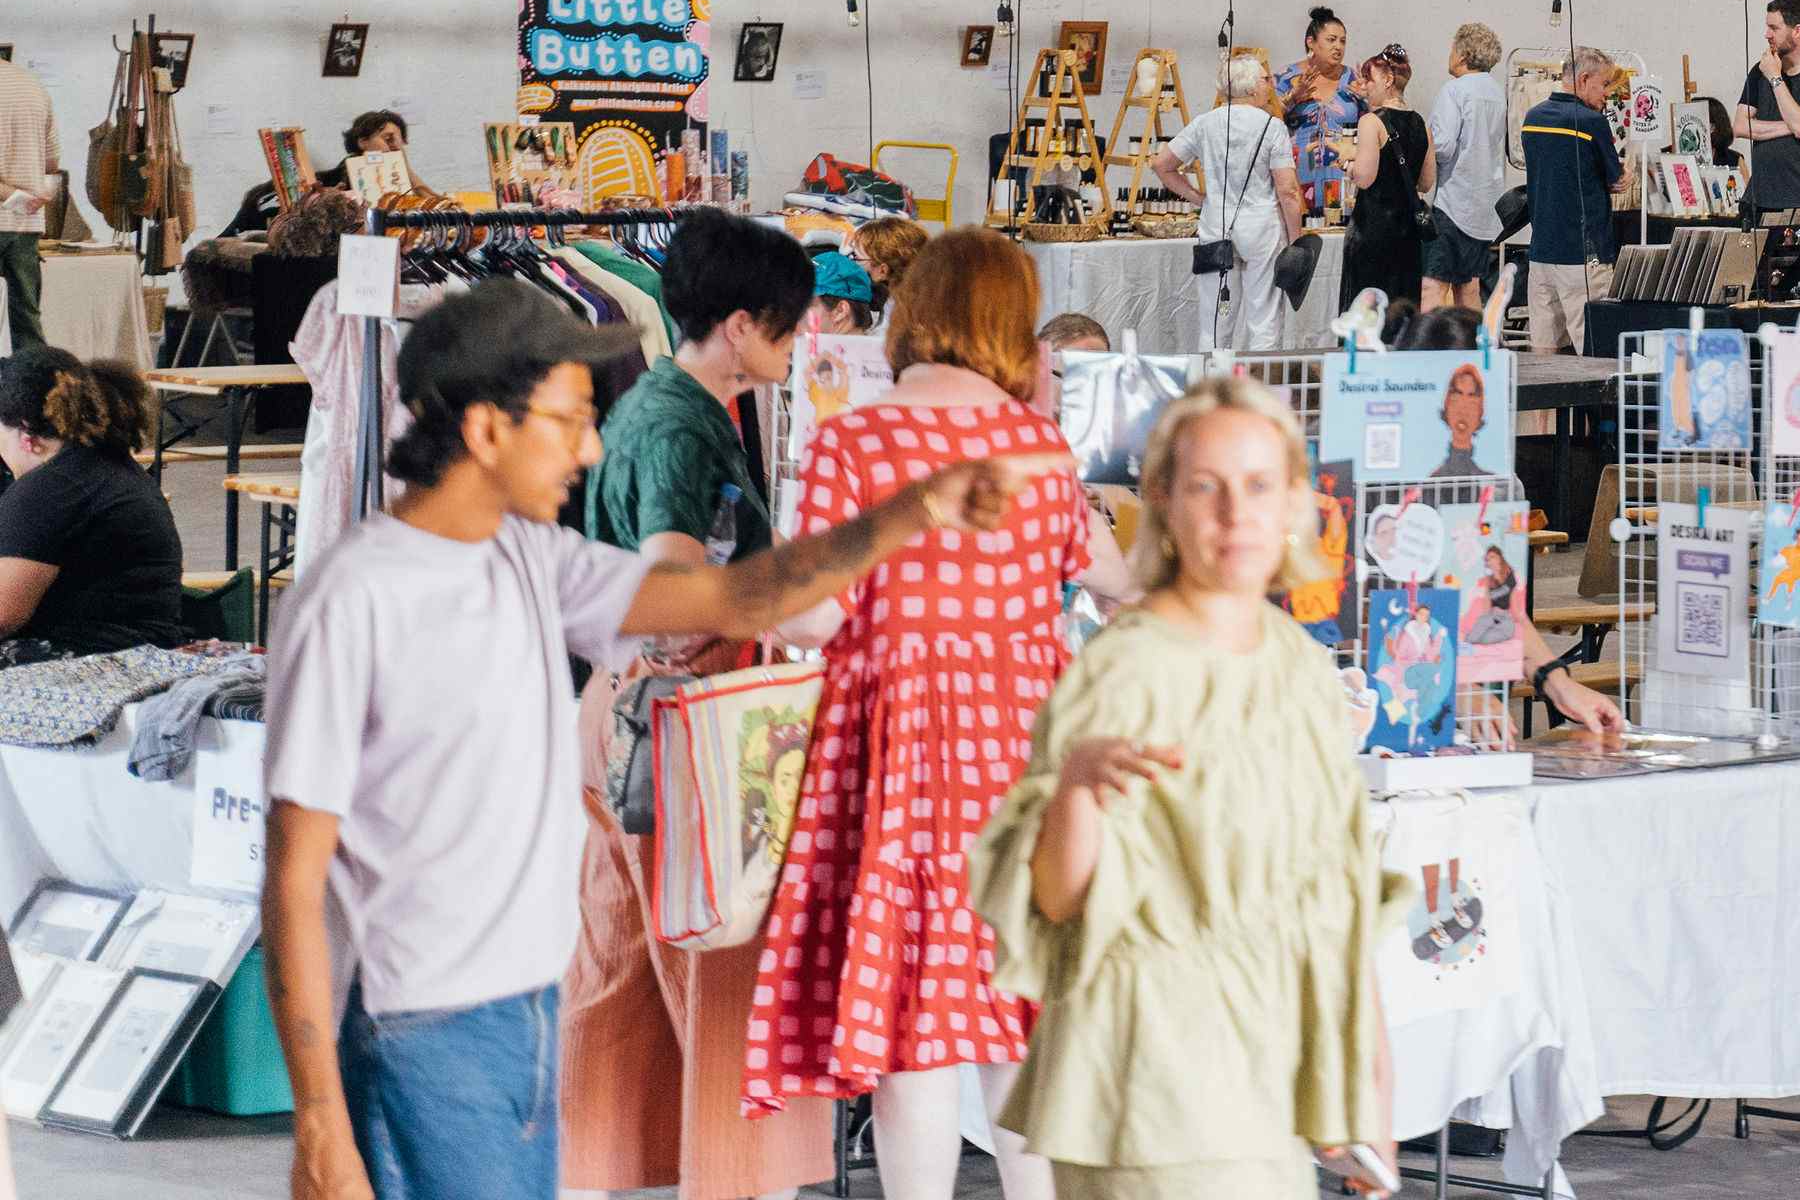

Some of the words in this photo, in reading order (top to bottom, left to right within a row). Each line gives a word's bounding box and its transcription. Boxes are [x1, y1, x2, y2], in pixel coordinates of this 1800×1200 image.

[537, 32, 698, 75] Butten
[610, 81, 660, 93] Aboriginal
[663, 83, 690, 93] Artist
[861, 366, 893, 380] Desira
[1383, 378, 1437, 393] Saunders
[1715, 529, 1735, 543] ART
[213, 786, 262, 822] Pre-
